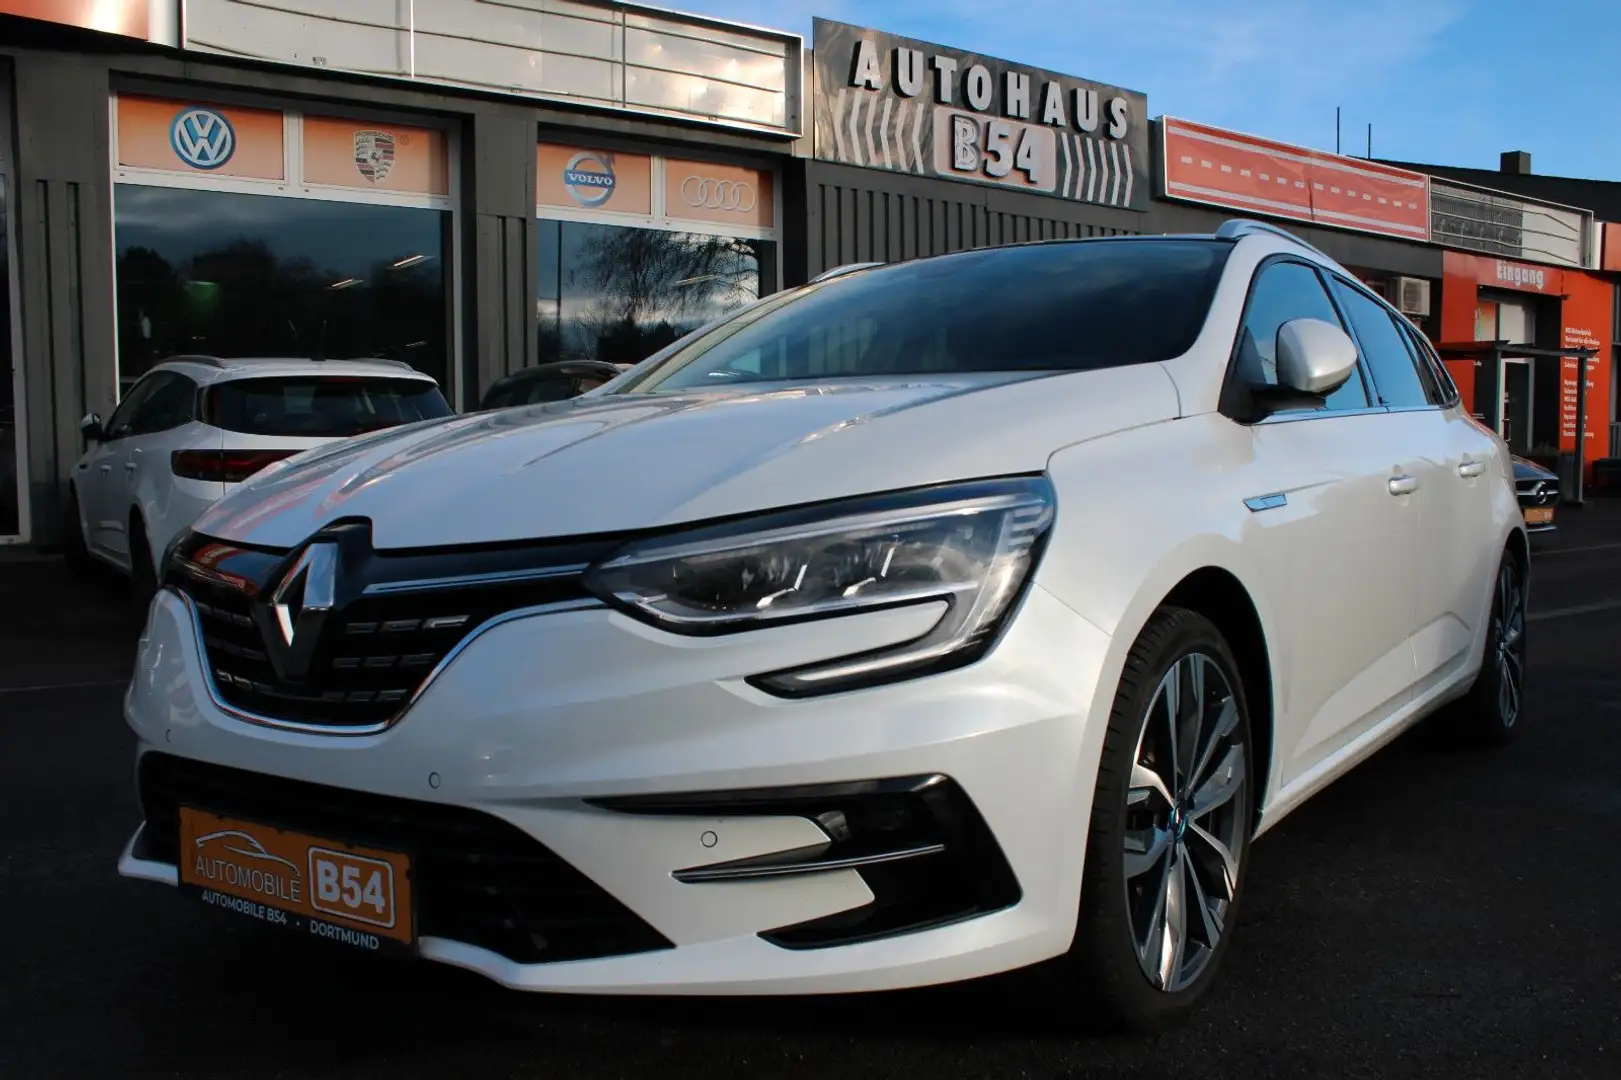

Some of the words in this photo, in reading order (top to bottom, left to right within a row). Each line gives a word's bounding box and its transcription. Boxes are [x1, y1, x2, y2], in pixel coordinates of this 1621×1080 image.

[849, 38, 1127, 139] AUTOHAUS
[951, 114, 1038, 184] B54
[567, 172, 613, 186] VOLVO
[1496, 259, 1544, 290] Eingang
[195, 855, 302, 904] AUTOMOBILE
[317, 859, 386, 914] B54
[202, 889, 265, 920] AUTOMOBILE
[267, 908, 288, 925] B54
[310, 920, 380, 950] DORTMUND
